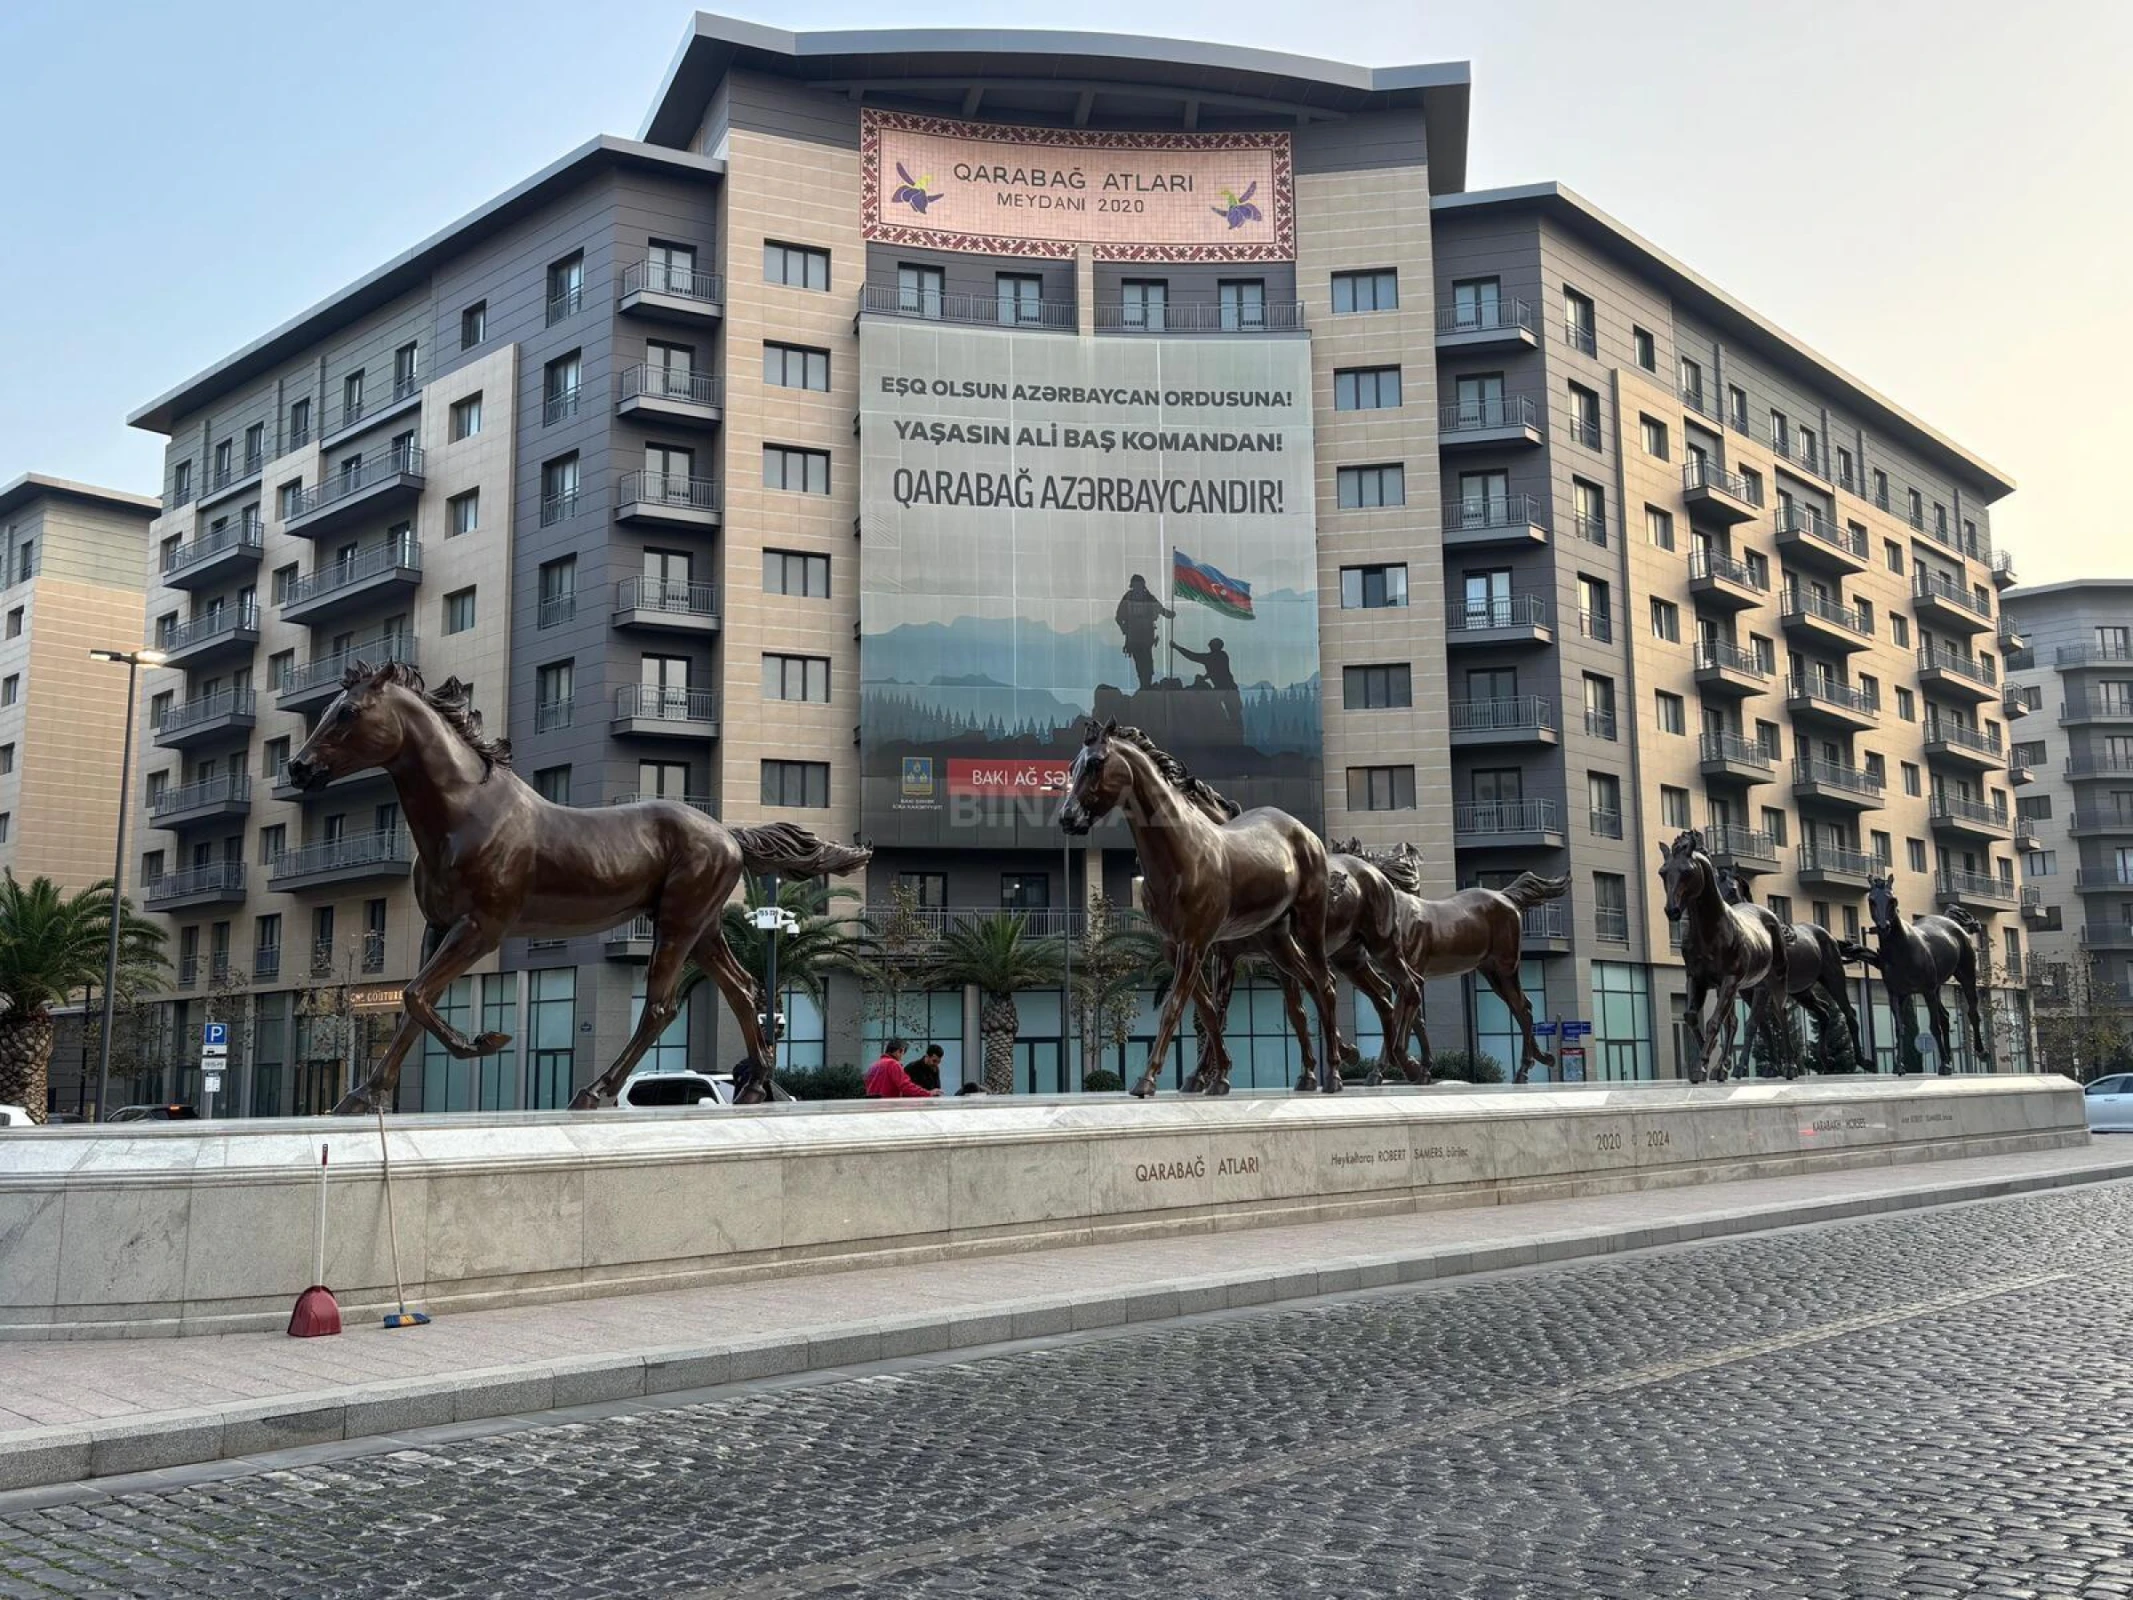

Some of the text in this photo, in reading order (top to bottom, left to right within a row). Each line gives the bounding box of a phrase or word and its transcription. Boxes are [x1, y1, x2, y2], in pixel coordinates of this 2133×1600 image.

[953, 163, 1194, 192] QARABAĞ ATLARI
[996, 192, 1144, 213] MEYDANI 2020
[881, 376, 1292, 408] EŞQ OLSUN AZƏRBAYCAN ORDUSUNA!
[893, 420, 1284, 454] YAŞASIN ALİ BAŞ KOMANDAN!
[893, 467, 1285, 514] QARABAĞ AZƏRBAYCANDIR!
[972, 769, 1008, 785] BAKI
[1014, 766, 1038, 786] AĞ
[211, 1026, 223, 1042] P
[1596, 1130, 1670, 1150] 2020 2024
[1378, 1149, 1406, 1162] ROBERT
[1135, 1155, 1260, 1182] QARABAĞ ATLARI
